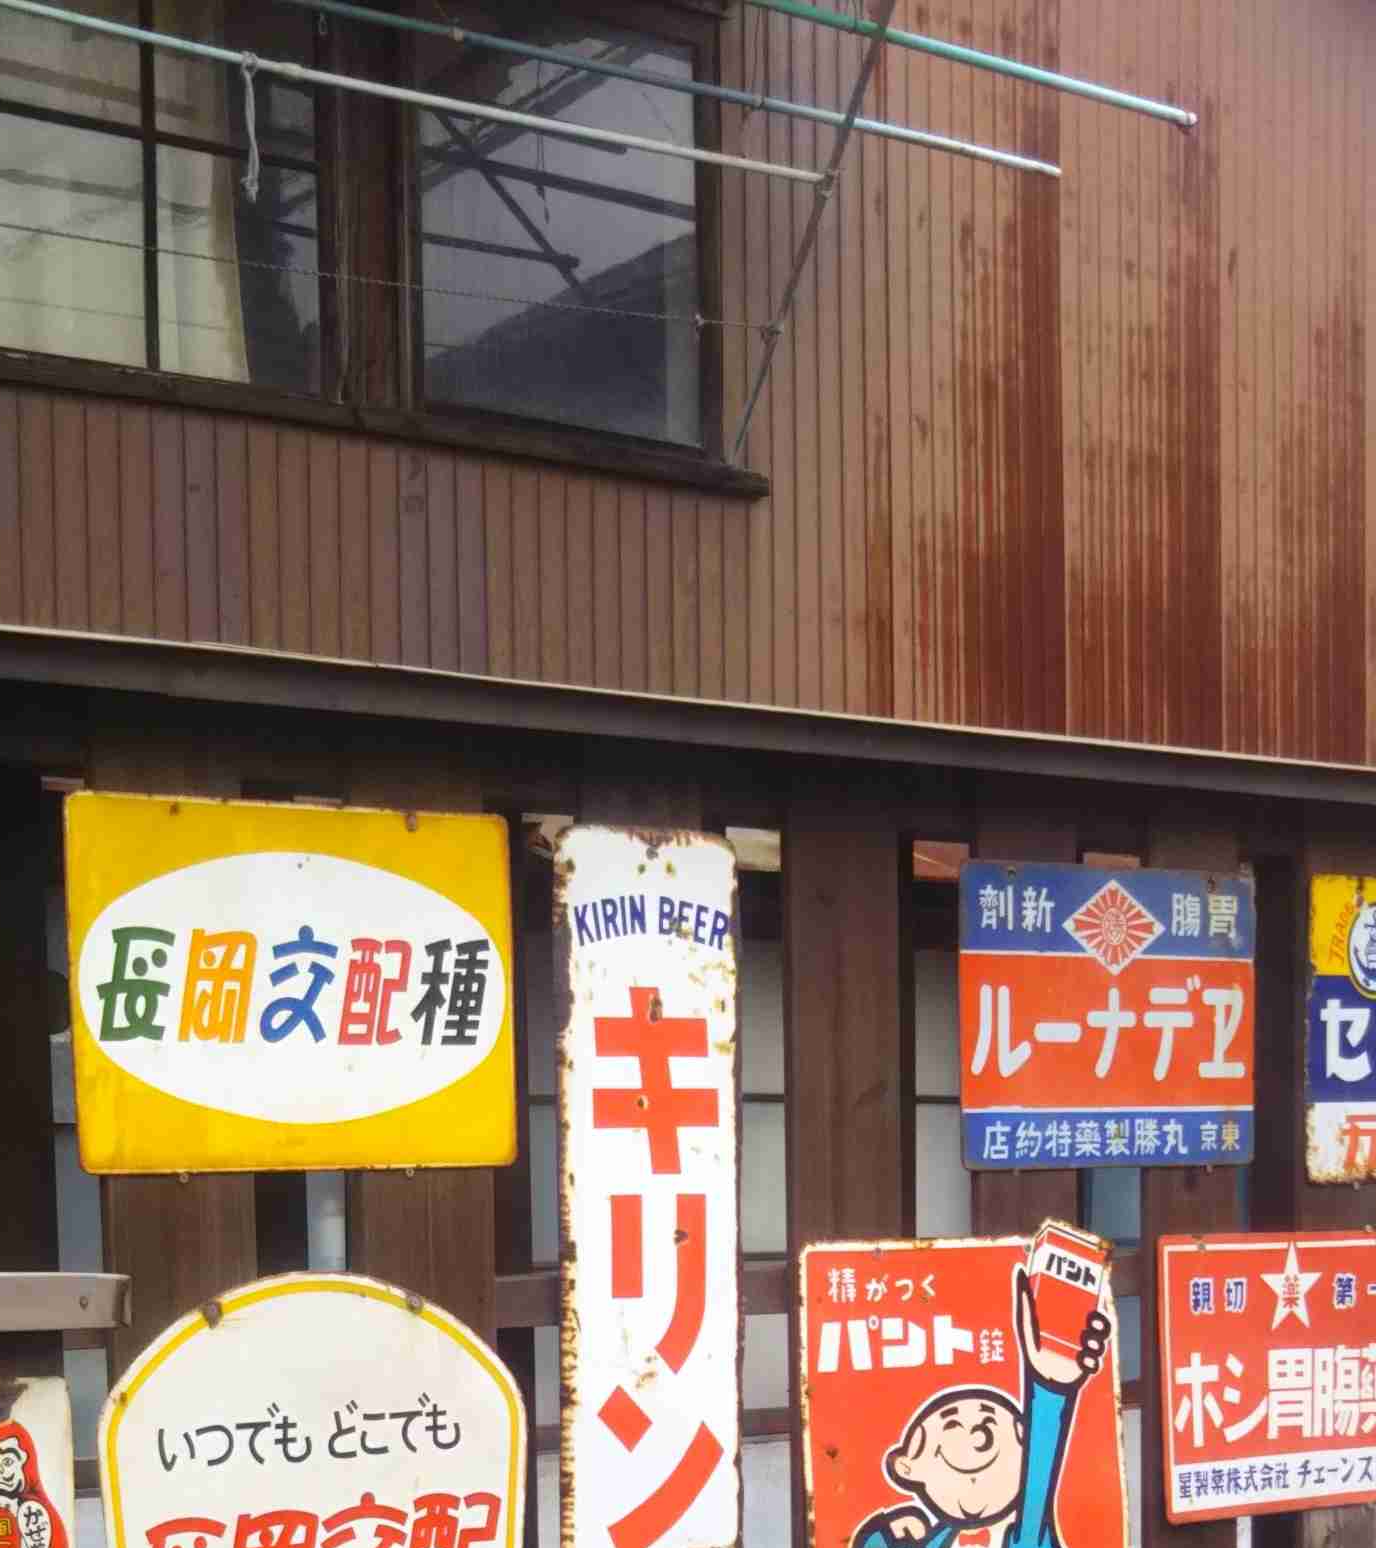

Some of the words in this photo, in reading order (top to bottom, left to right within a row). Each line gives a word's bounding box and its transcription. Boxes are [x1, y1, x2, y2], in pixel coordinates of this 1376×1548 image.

[573, 895, 648, 948] KIRIN
[658, 896, 729, 951] BEER
[97, 924, 492, 1046] 長岡交配種
[1045, 1253, 1097, 1288] パント
[157, 1403, 312, 1472] いつでも
[327, 1392, 461, 1460] どこでも
